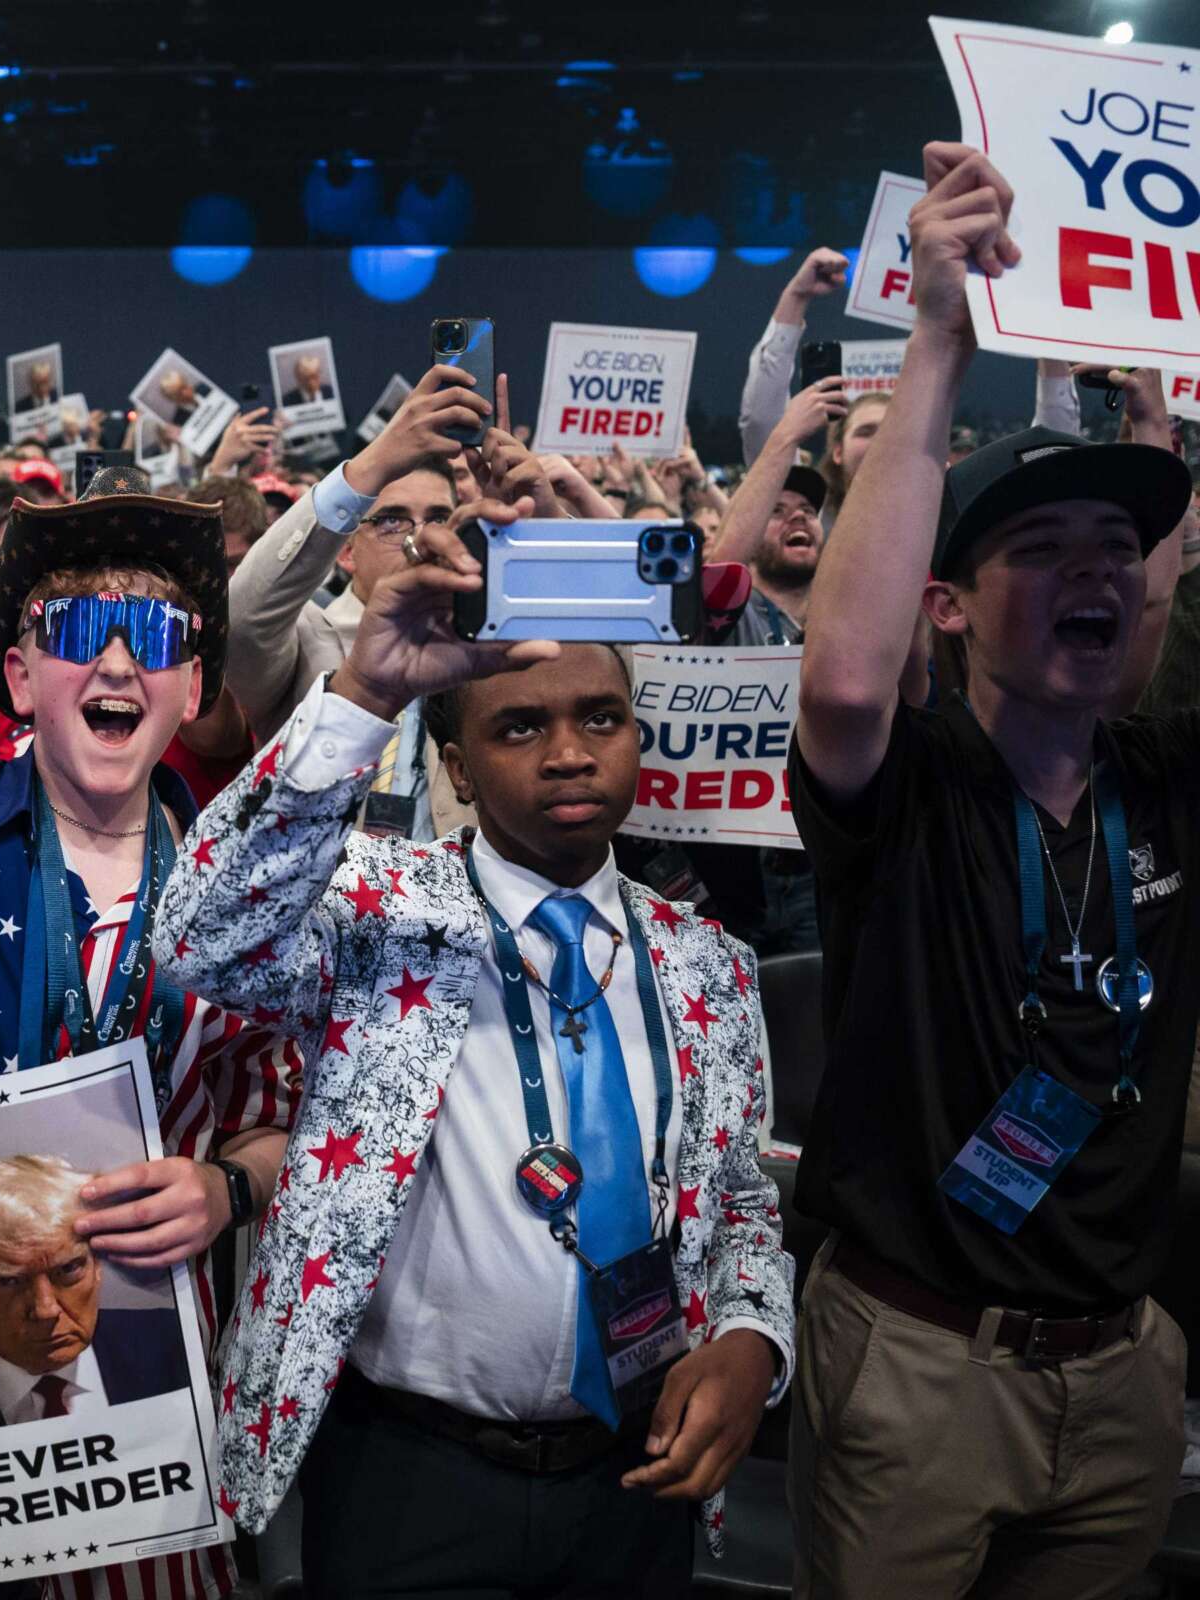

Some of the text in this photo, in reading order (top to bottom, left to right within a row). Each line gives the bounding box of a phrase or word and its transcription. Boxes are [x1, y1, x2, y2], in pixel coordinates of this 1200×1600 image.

[1060, 87, 1194, 148] JOE
[573, 349, 612, 369] JOE
[569, 375, 664, 404] YOU'RE
[560, 407, 664, 437] FIRED!
[667, 683, 789, 713] BIDEN,
[635, 717, 791, 760] U'RE
[635, 766, 794, 812] RED!
[973, 1145, 1039, 1191] STUDENT
[986, 1166, 1010, 1187] VIP
[615, 1326, 678, 1369] STUDENT
[639, 1349, 661, 1369] VIP
